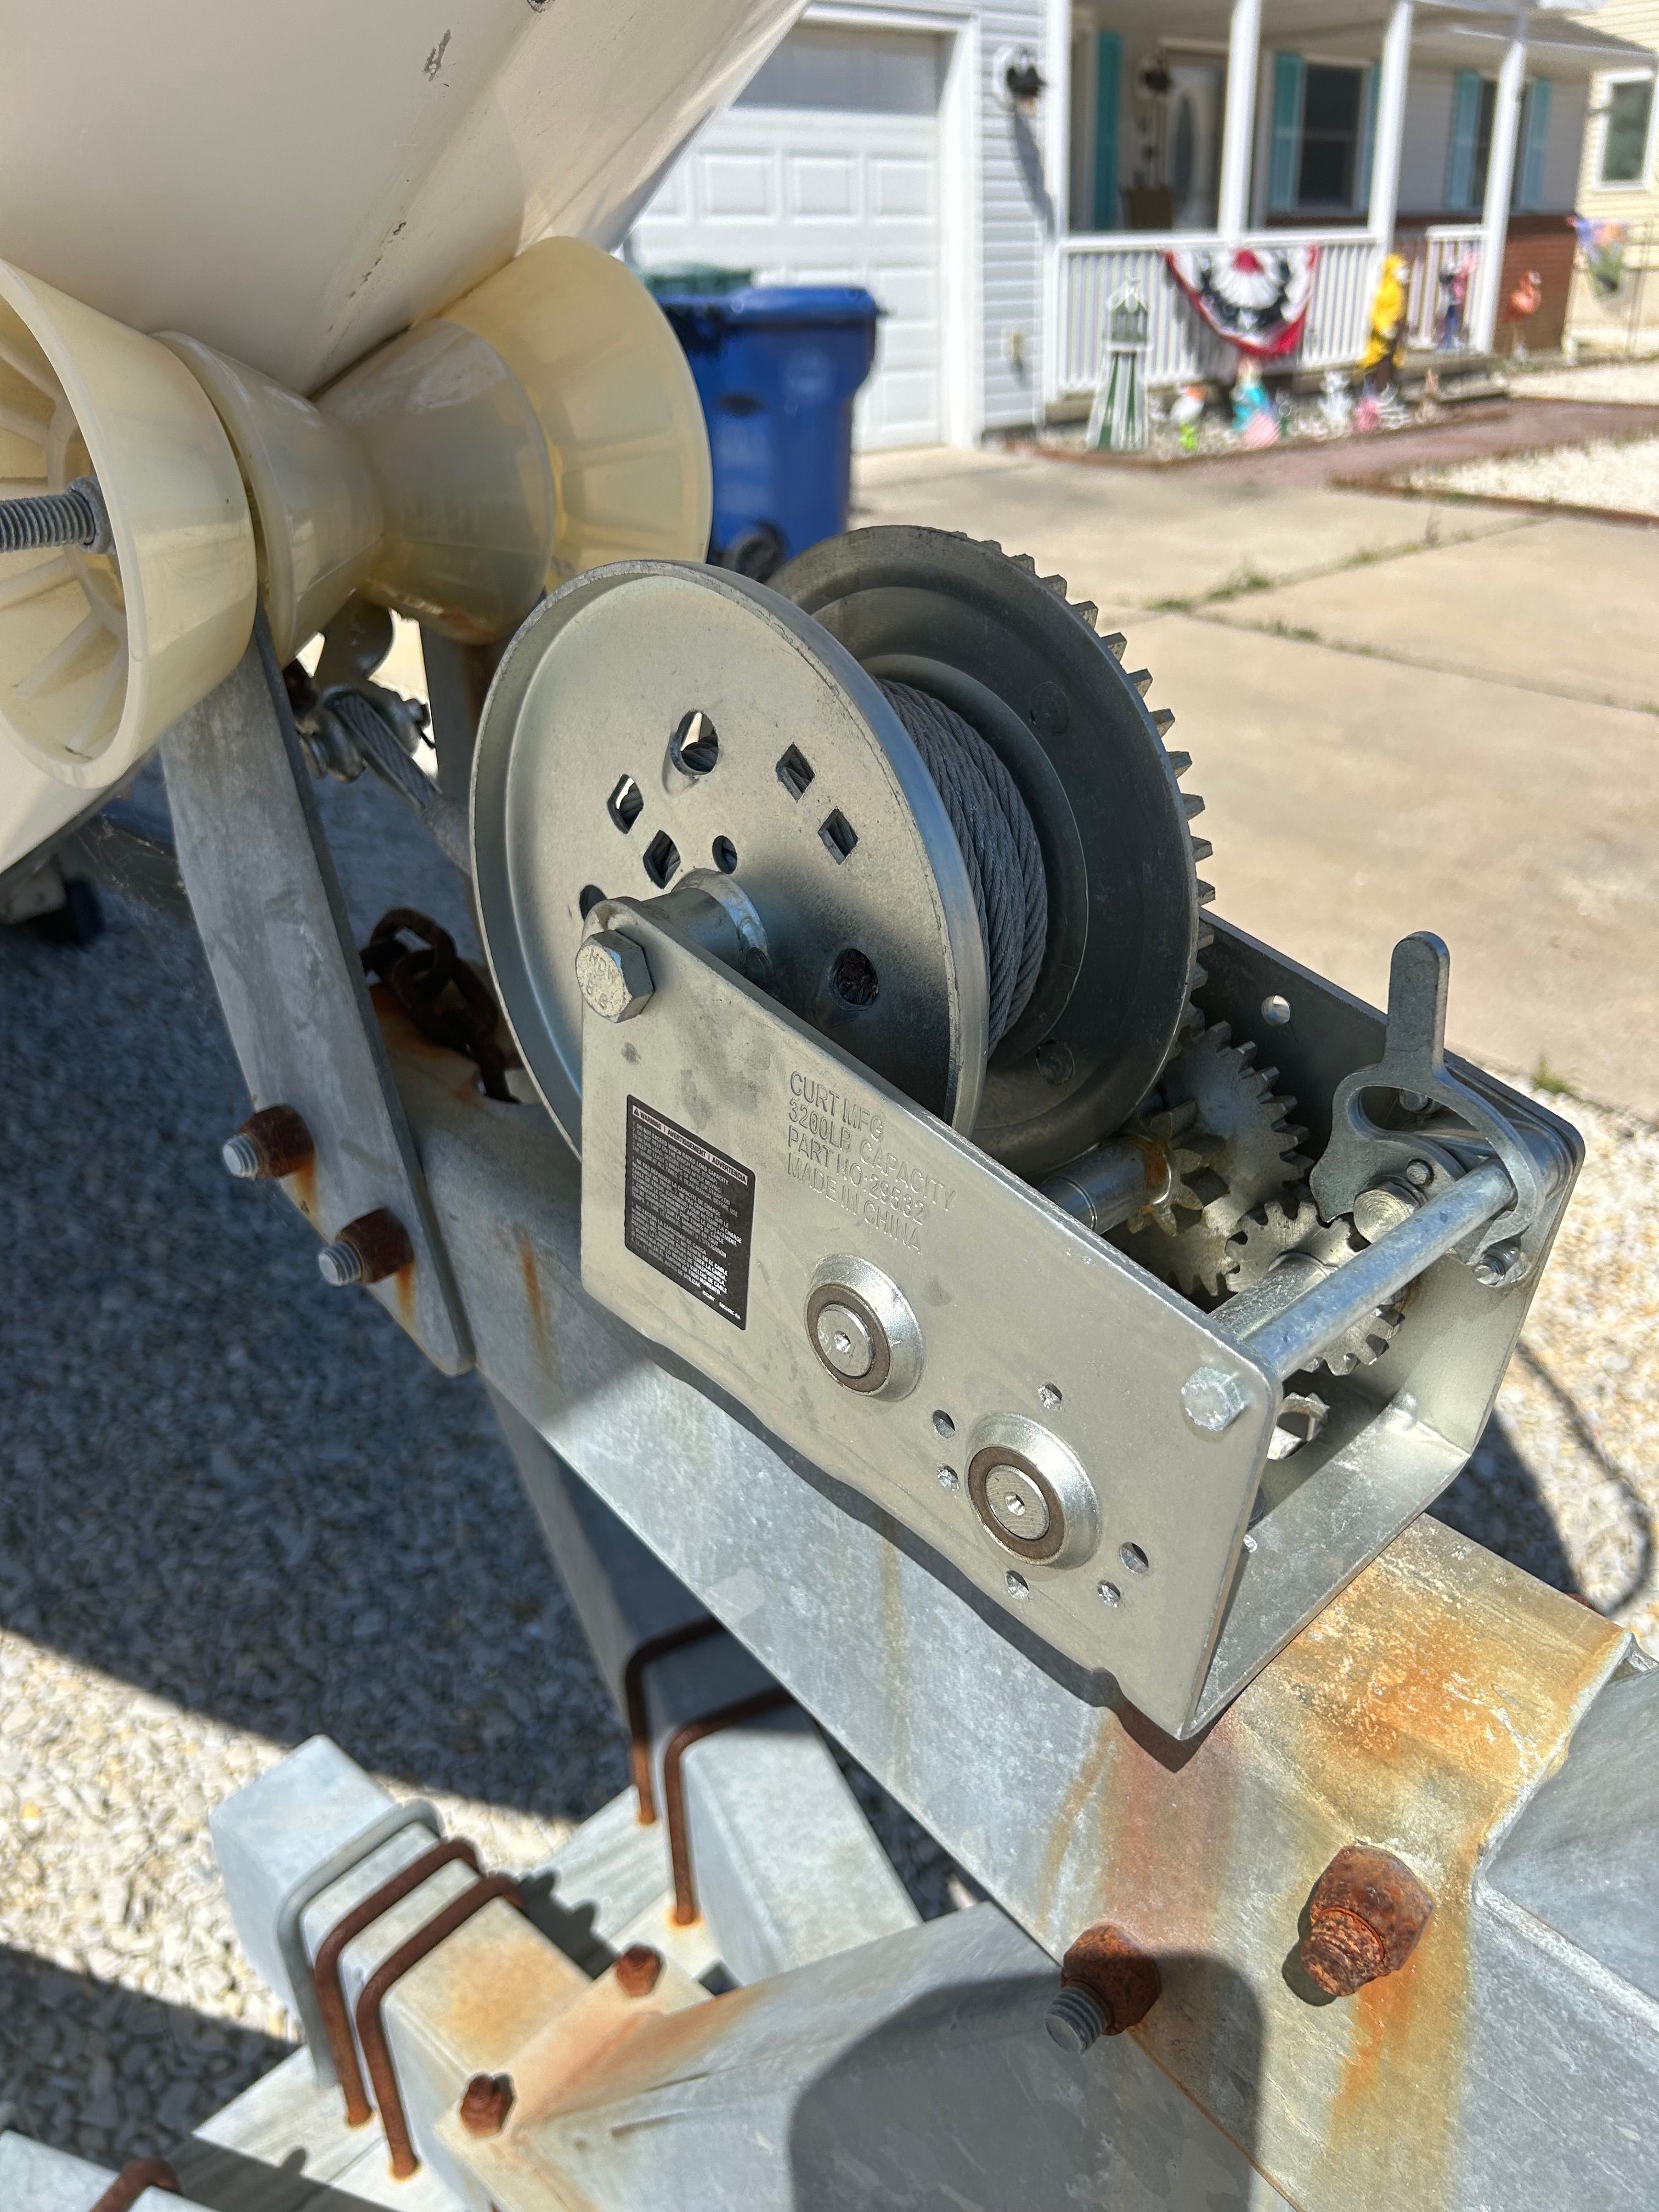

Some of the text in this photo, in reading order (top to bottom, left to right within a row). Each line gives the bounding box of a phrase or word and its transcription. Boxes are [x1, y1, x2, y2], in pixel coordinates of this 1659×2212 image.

[790, 1070, 885, 1142] CURT MFG
[640, 1111, 746, 1183] WARNING AVERTISSEMENT ADVERTENCIA
[682, 1151, 696, 1165] RATED
[696, 1160, 707, 1172] LOAD
[788, 1125, 834, 1169] PART
[788, 1097, 956, 1212] 3200LB CAPACITY
[787, 1152, 922, 1255] MADE IN CHINA
[714, 1262, 728, 1276] CABLE
